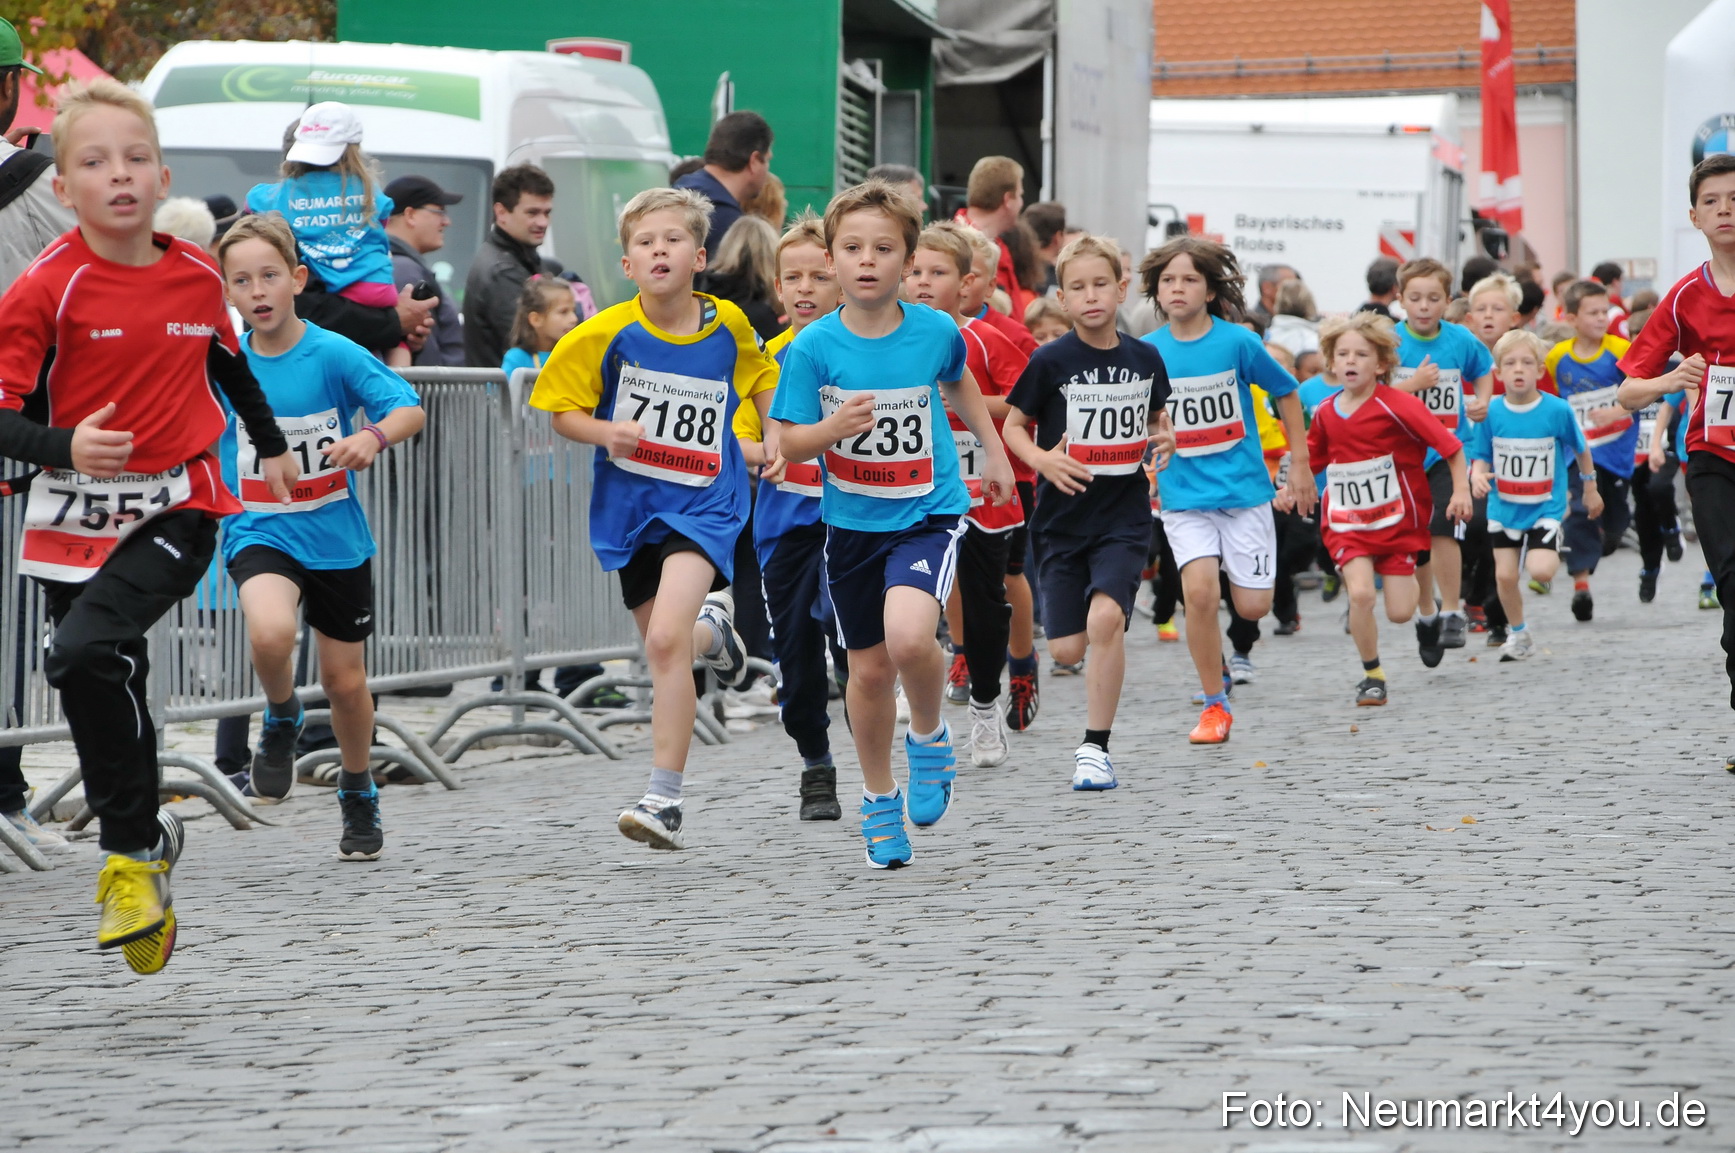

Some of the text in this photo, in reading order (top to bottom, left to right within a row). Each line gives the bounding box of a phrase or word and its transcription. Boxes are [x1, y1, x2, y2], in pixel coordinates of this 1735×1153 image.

[307, 70, 409, 86] Europcar
[293, 212, 365, 228] STADTLAU
[1235, 214, 1344, 232] Bayerisches
[1235, 236, 1285, 251] Rotes
[101, 328, 122, 337] JAKO
[167, 322, 181, 336] FC
[622, 376, 713, 401] PARTL Neumarkt
[1184, 382, 1224, 393] Neumarkt
[873, 399, 914, 411] umarkt
[1070, 391, 1143, 402] PARTL Neumarkt
[1716, 389, 1733, 420] 7
[1165, 392, 1234, 426] 7600
[630, 392, 717, 446] 7188
[1079, 403, 1145, 440] 7093
[281, 424, 323, 436] eumarkt
[248, 436, 336, 474] 712
[633, 445, 704, 471] onstantin
[1086, 449, 1140, 462] Johannes
[854, 465, 895, 482] Louis
[1499, 454, 1548, 477] 7071
[1334, 474, 1389, 506] 7017
[48, 486, 171, 530] 7551
